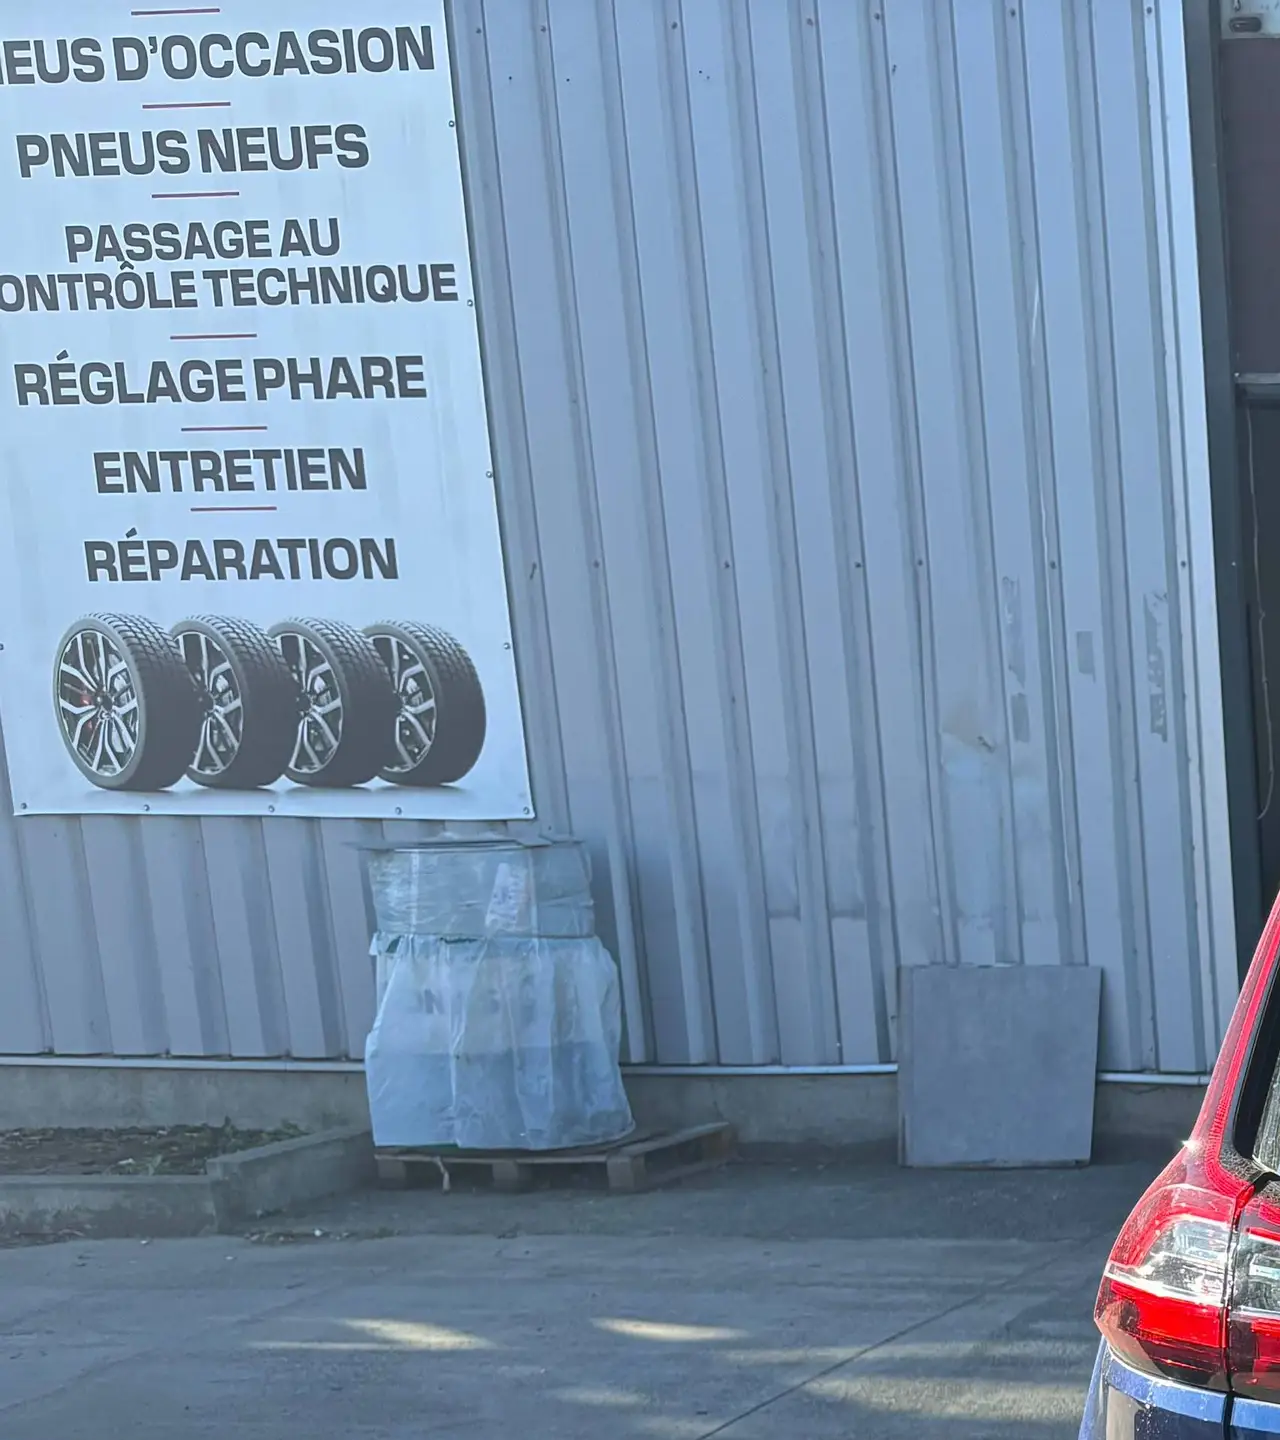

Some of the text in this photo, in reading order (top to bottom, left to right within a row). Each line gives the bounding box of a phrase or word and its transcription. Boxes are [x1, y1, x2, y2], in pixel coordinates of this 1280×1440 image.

[0, 26, 435, 85] EUS D'OCCASION
[16, 124, 370, 178] PNEUS NEUFS
[65, 218, 340, 262] PASSAGE AU
[202, 264, 458, 308] TECHNIQUE
[14, 349, 428, 406] RÉGLAGE PHARE
[93, 448, 367, 493] ENTRETIEN
[84, 527, 399, 581] RÉPARATION
